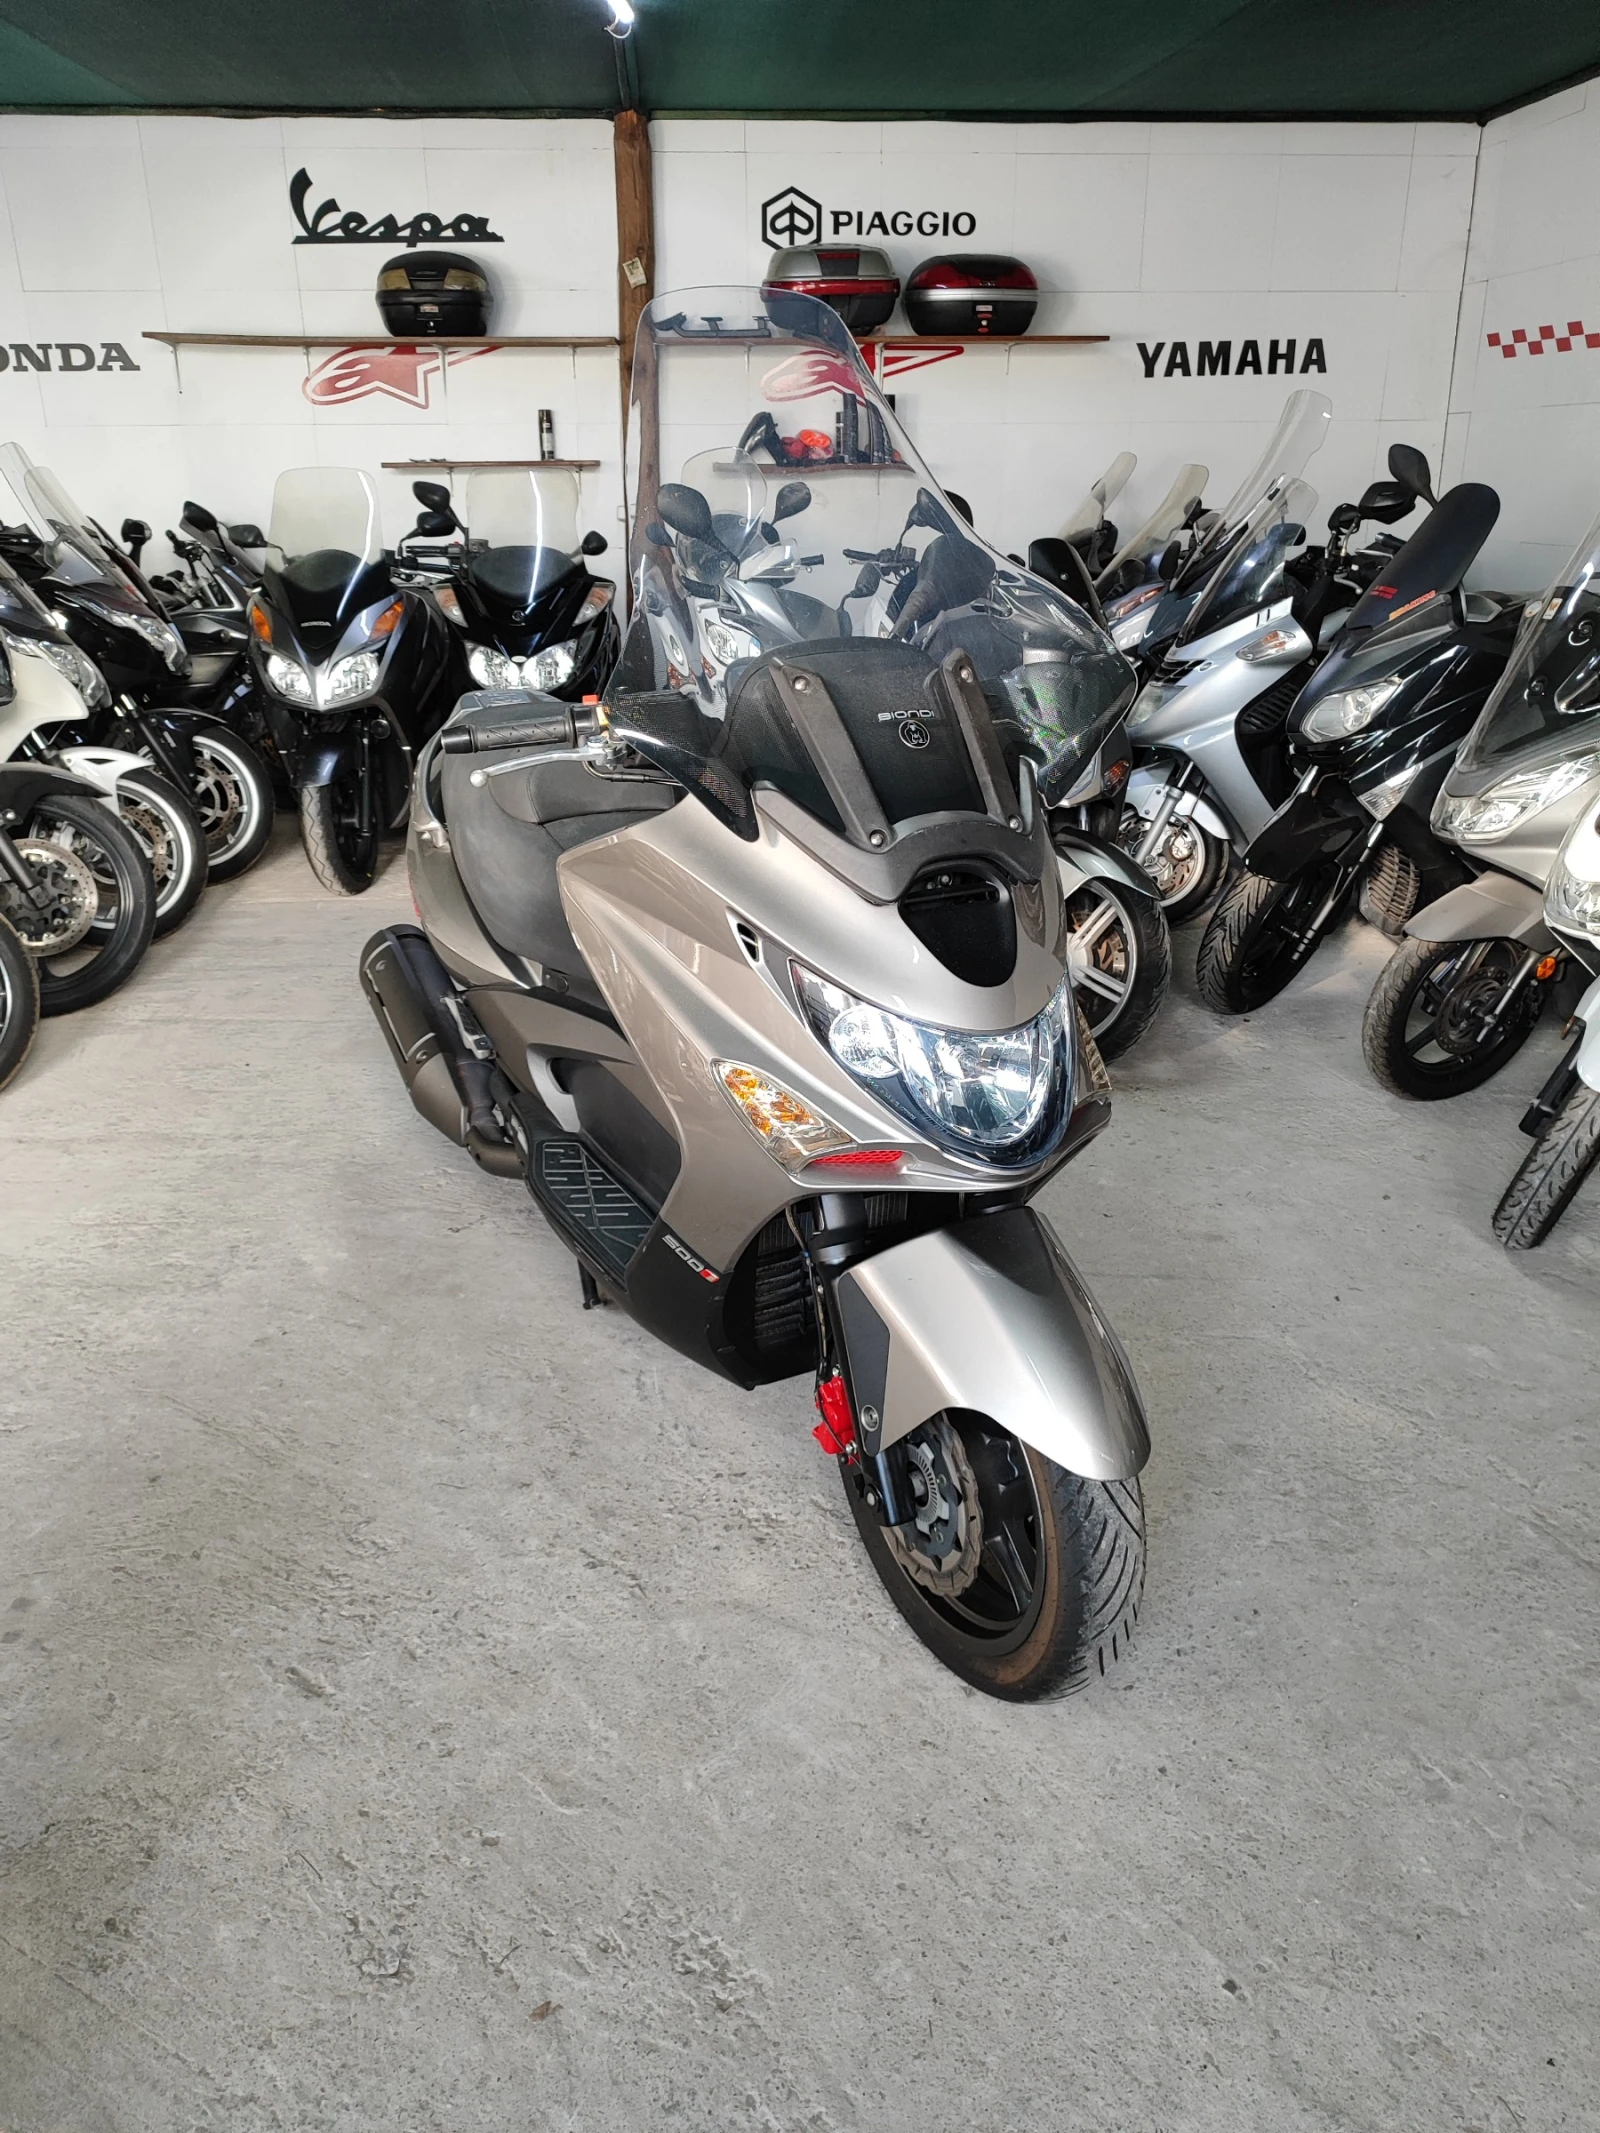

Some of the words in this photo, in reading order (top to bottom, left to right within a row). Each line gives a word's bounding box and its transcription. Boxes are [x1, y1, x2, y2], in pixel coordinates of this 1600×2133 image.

[290, 167, 505, 248] Vespa
[829, 210, 977, 237] PIAGGIO
[1136, 338, 1327, 379] YAMAHA
[877, 709, 935, 723] BIONDI
